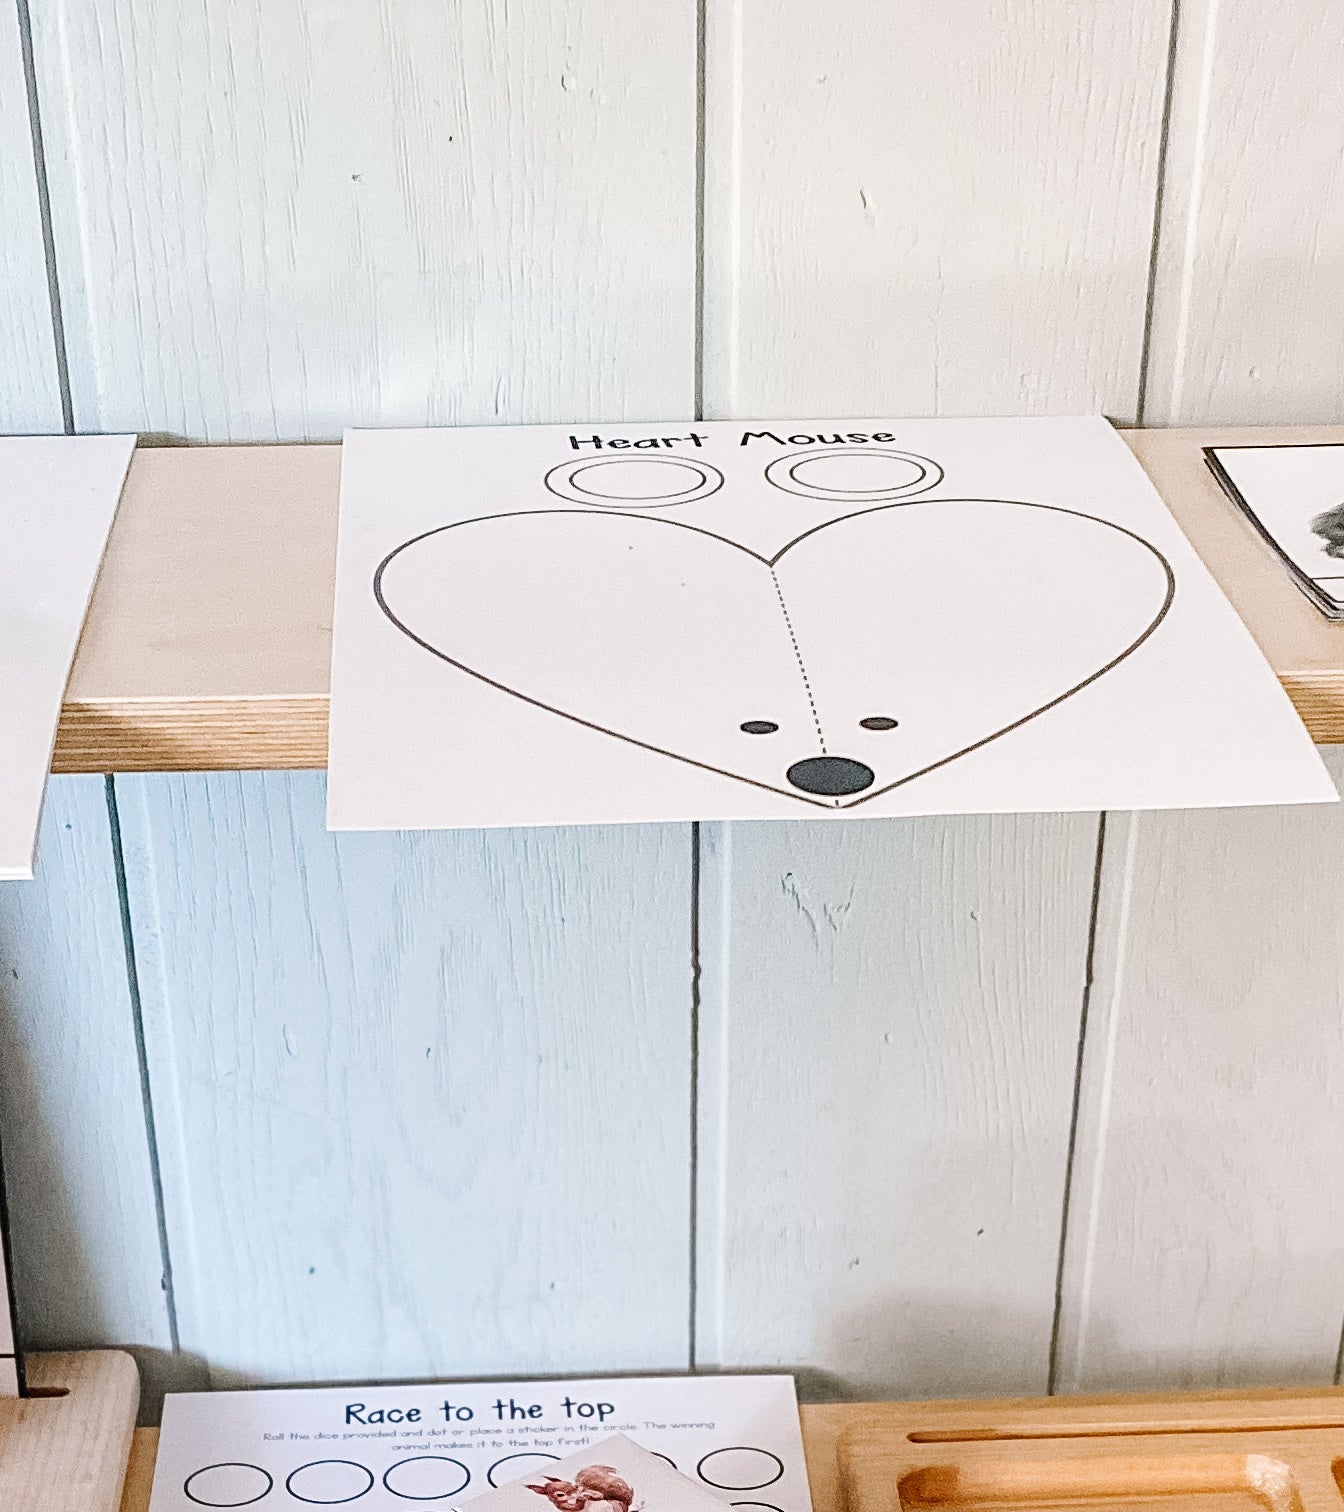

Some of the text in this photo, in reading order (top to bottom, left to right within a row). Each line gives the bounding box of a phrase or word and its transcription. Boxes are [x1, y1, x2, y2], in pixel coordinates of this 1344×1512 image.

[569, 429, 898, 450] Heart Mouse
[345, 1397, 615, 1425] Race to the top
[263, 1433, 285, 1441] Roll
[289, 1432, 310, 1440] the
[313, 1431, 339, 1440] dice
[342, 1429, 397, 1440] provided
[400, 1429, 423, 1437] and
[427, 1428, 446, 1436] dot
[469, 1427, 502, 1437] place
[518, 1425, 558, 1433] sticker
[644, 1421, 667, 1429] The
[671, 1422, 715, 1430] winning
[392, 1442, 430, 1450] animal
[434, 1441, 473, 1449] makes
[535, 1438, 554, 1447] top
